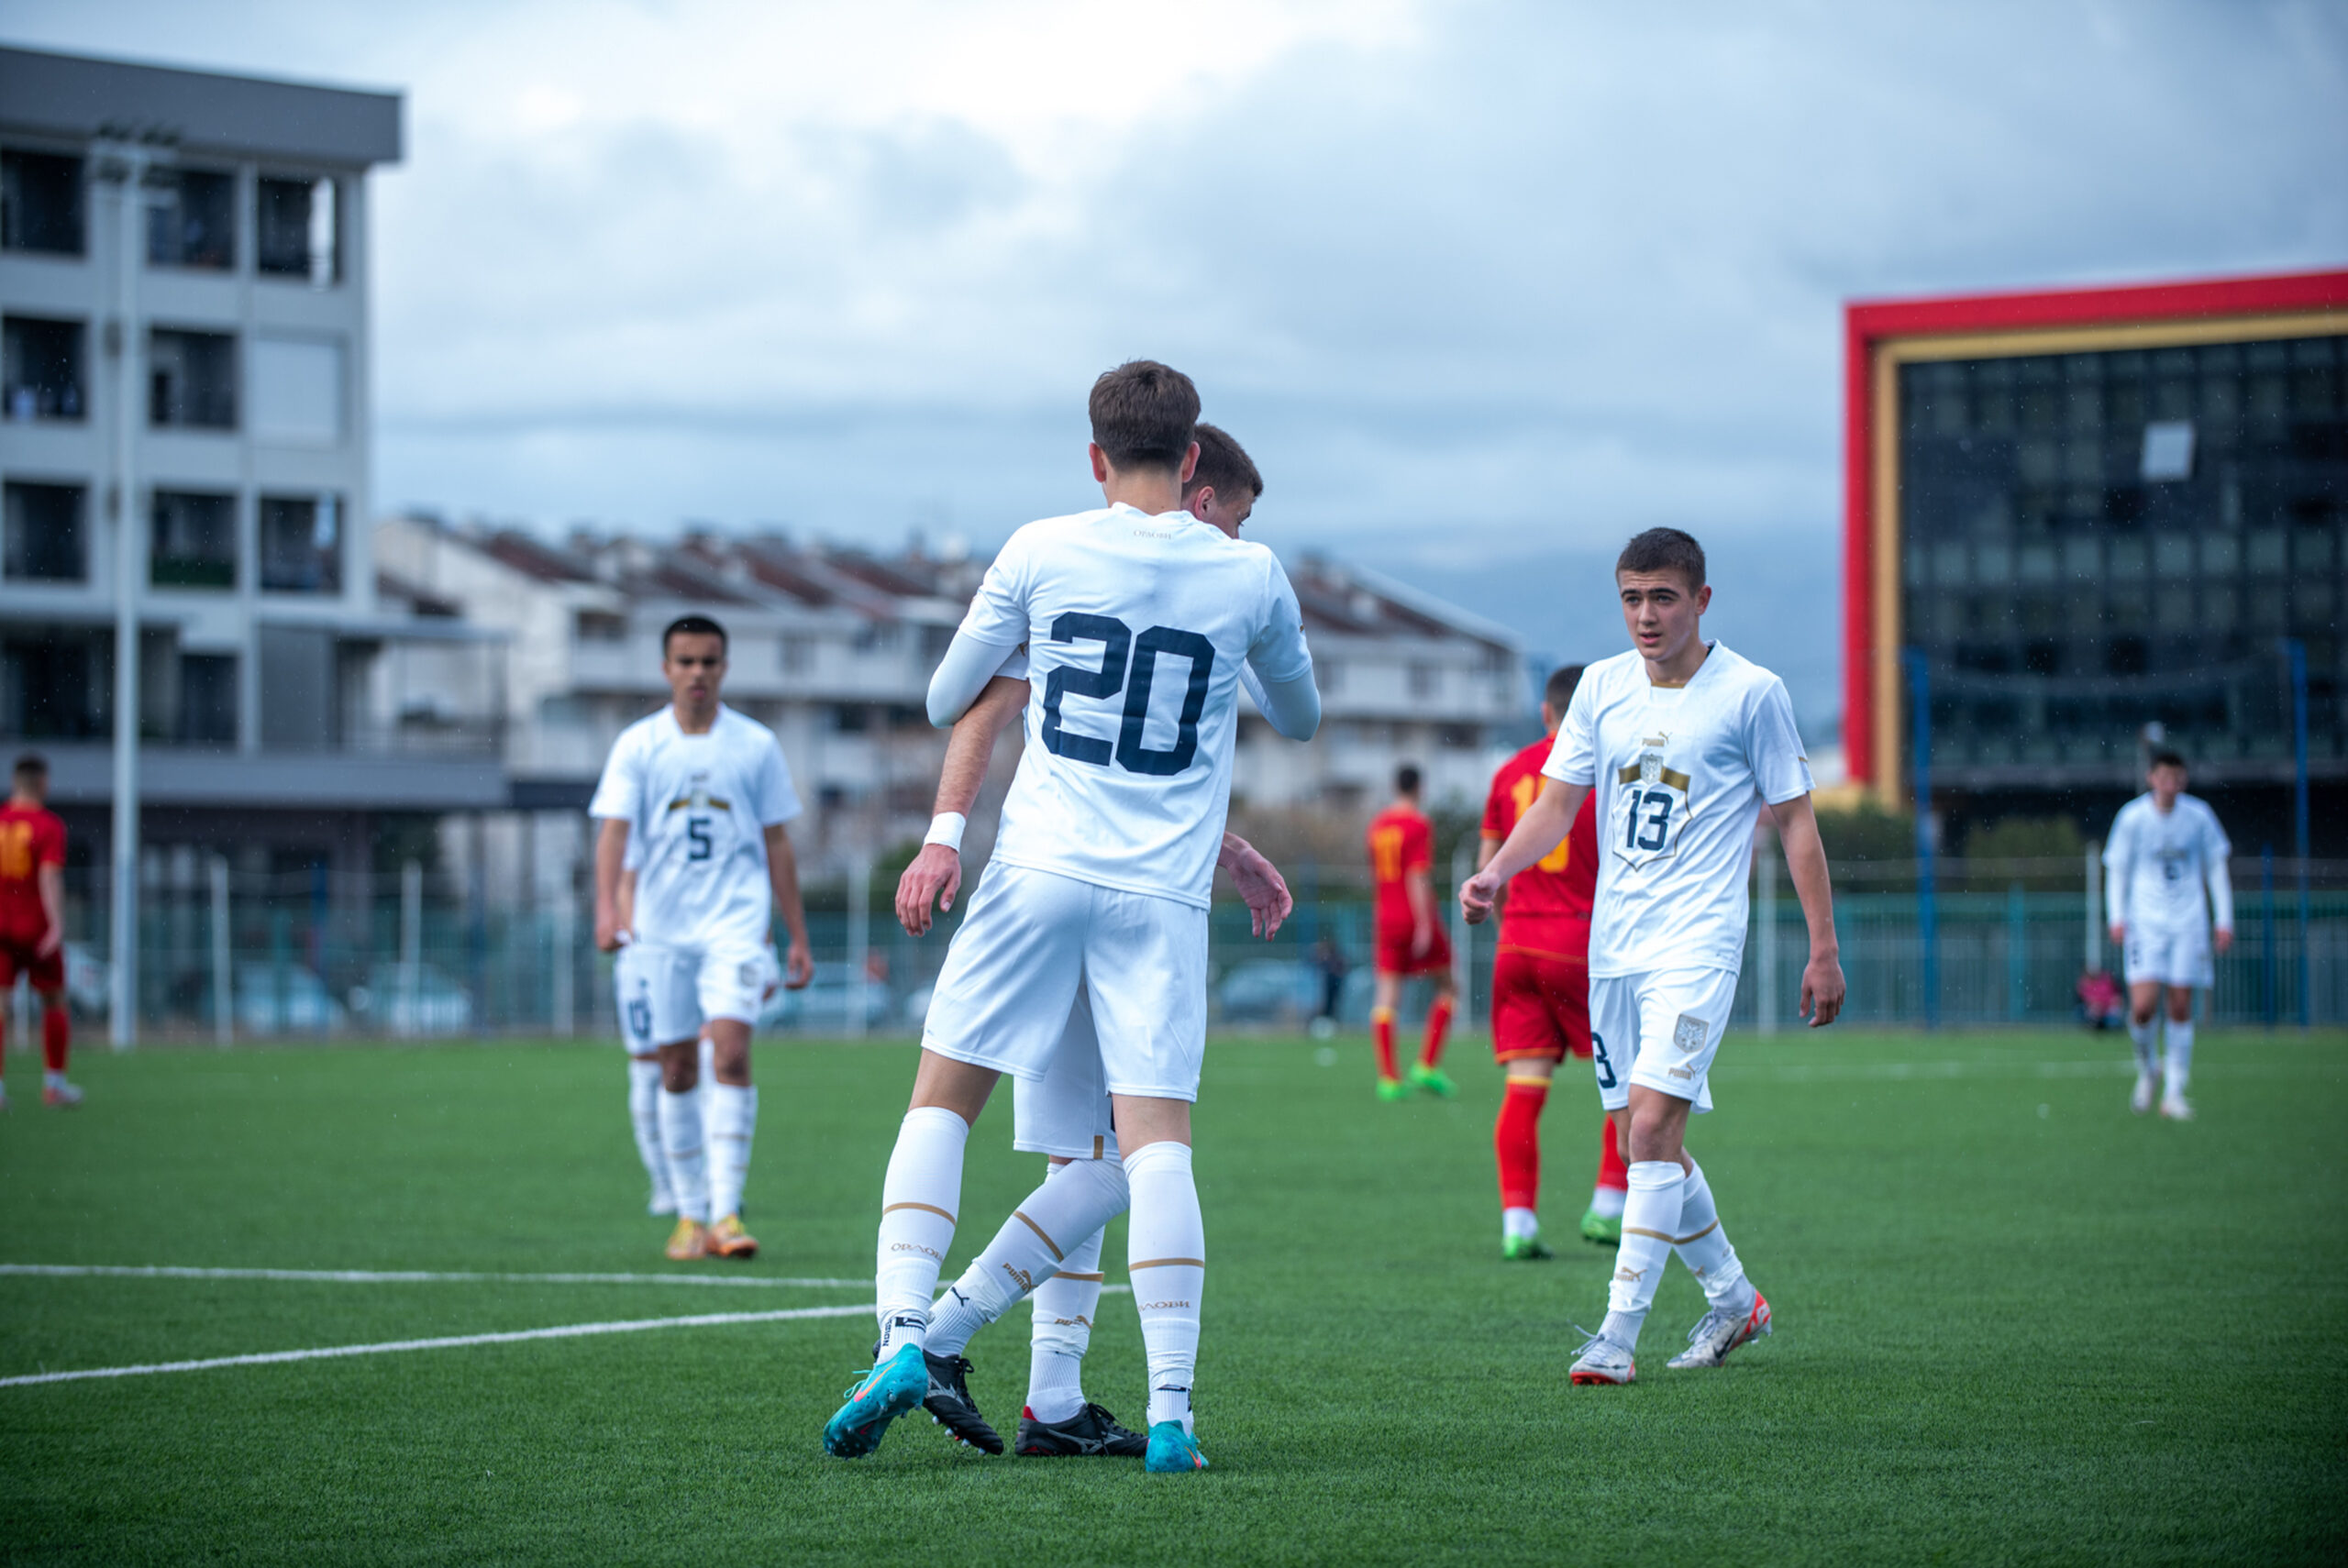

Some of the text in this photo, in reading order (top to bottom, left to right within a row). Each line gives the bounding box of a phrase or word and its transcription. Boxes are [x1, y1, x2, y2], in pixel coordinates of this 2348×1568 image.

[1042, 611, 1216, 777] 20
[689, 818, 711, 861] 5
[1626, 789, 1674, 852] 13
[1668, 1067, 1691, 1080] PUMA
[1002, 1262, 1029, 1292] PUMA
